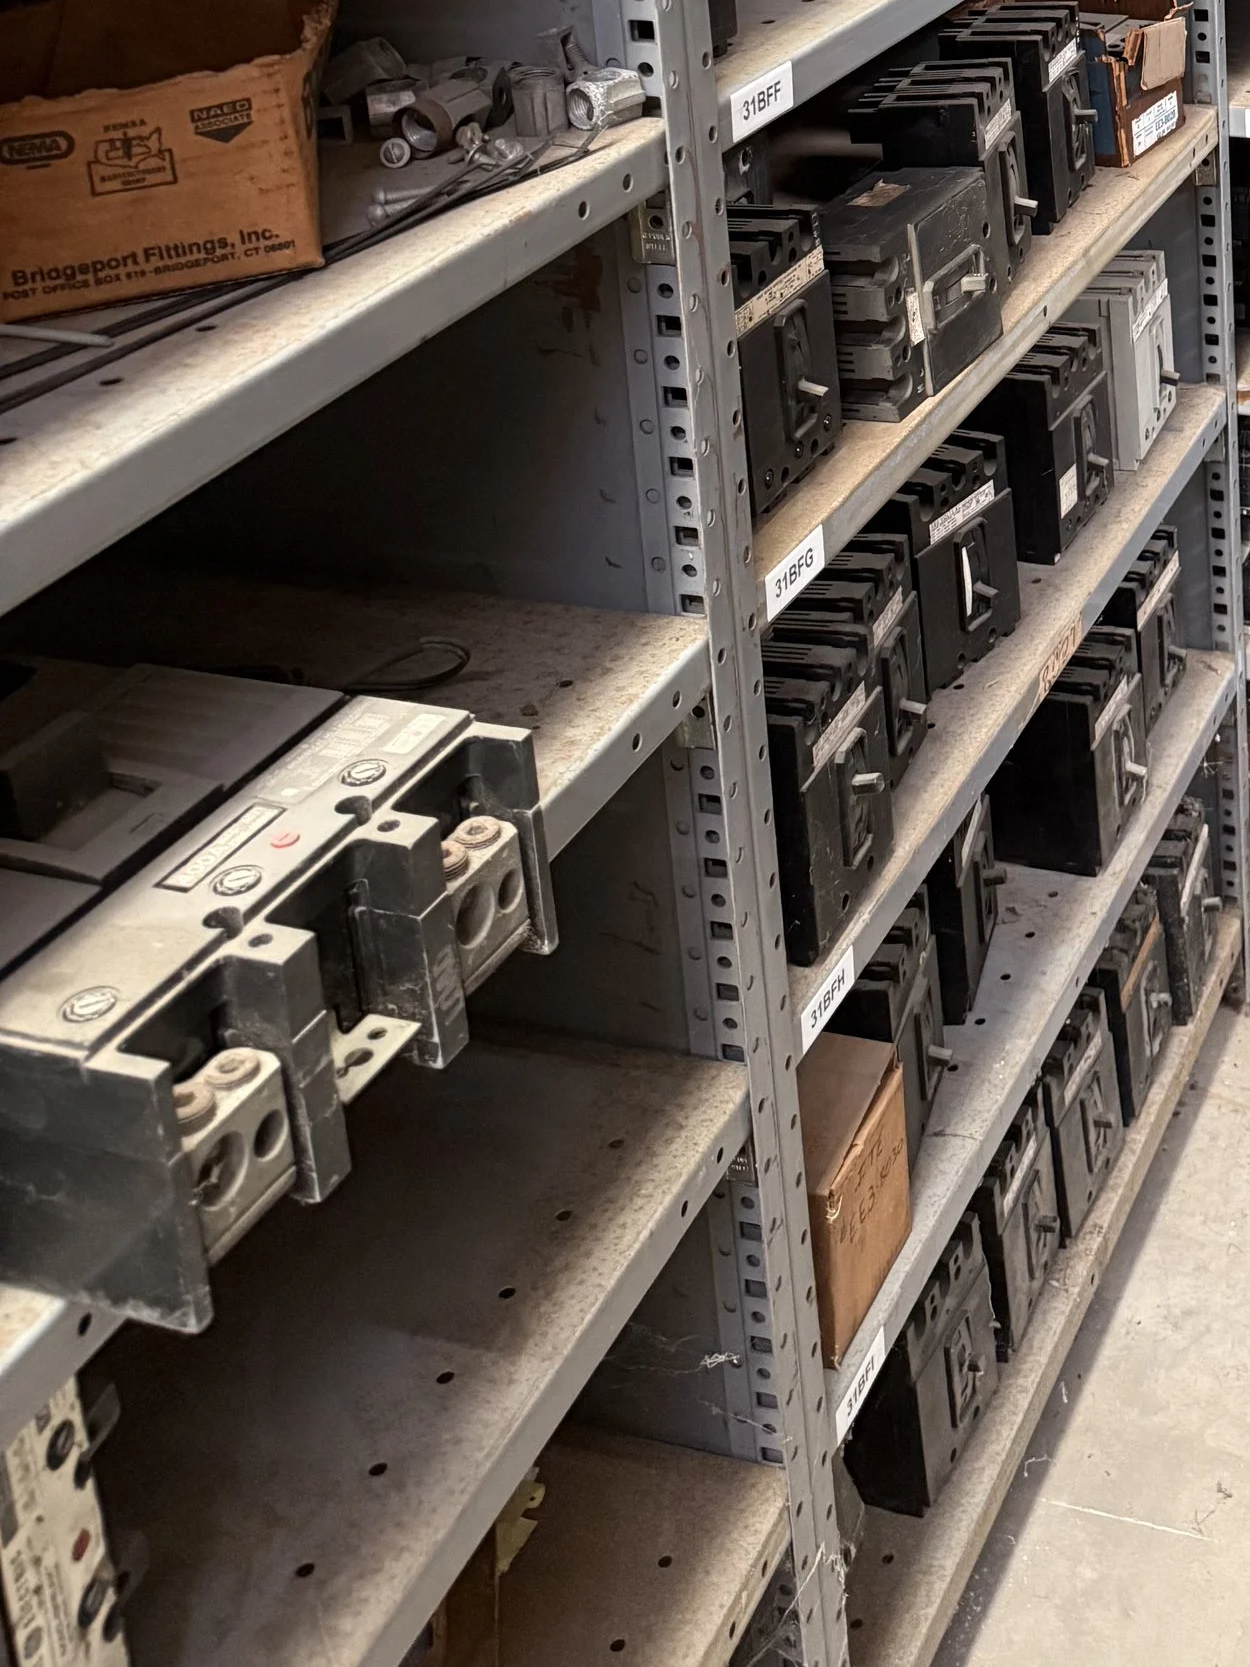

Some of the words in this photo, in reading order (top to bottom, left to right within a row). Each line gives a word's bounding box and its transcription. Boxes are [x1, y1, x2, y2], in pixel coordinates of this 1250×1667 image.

[193, 100, 251, 122] NAED
[194, 113, 252, 132] ASSOCIATE
[743, 81, 782, 121] 31BFF
[2, 287, 37, 302] POST
[42, 279, 91, 295] OFFICE
[94, 274, 122, 287] BOX
[244, 246, 260, 258] CT
[11, 249, 138, 288] Bridgeport
[143, 236, 237, 265] Fittings,
[239, 225, 280, 246] Inc.
[775, 548, 814, 600] 31BFG
[810, 968, 846, 1030] 31BFH
[846, 1355, 875, 1417] 31BFI
